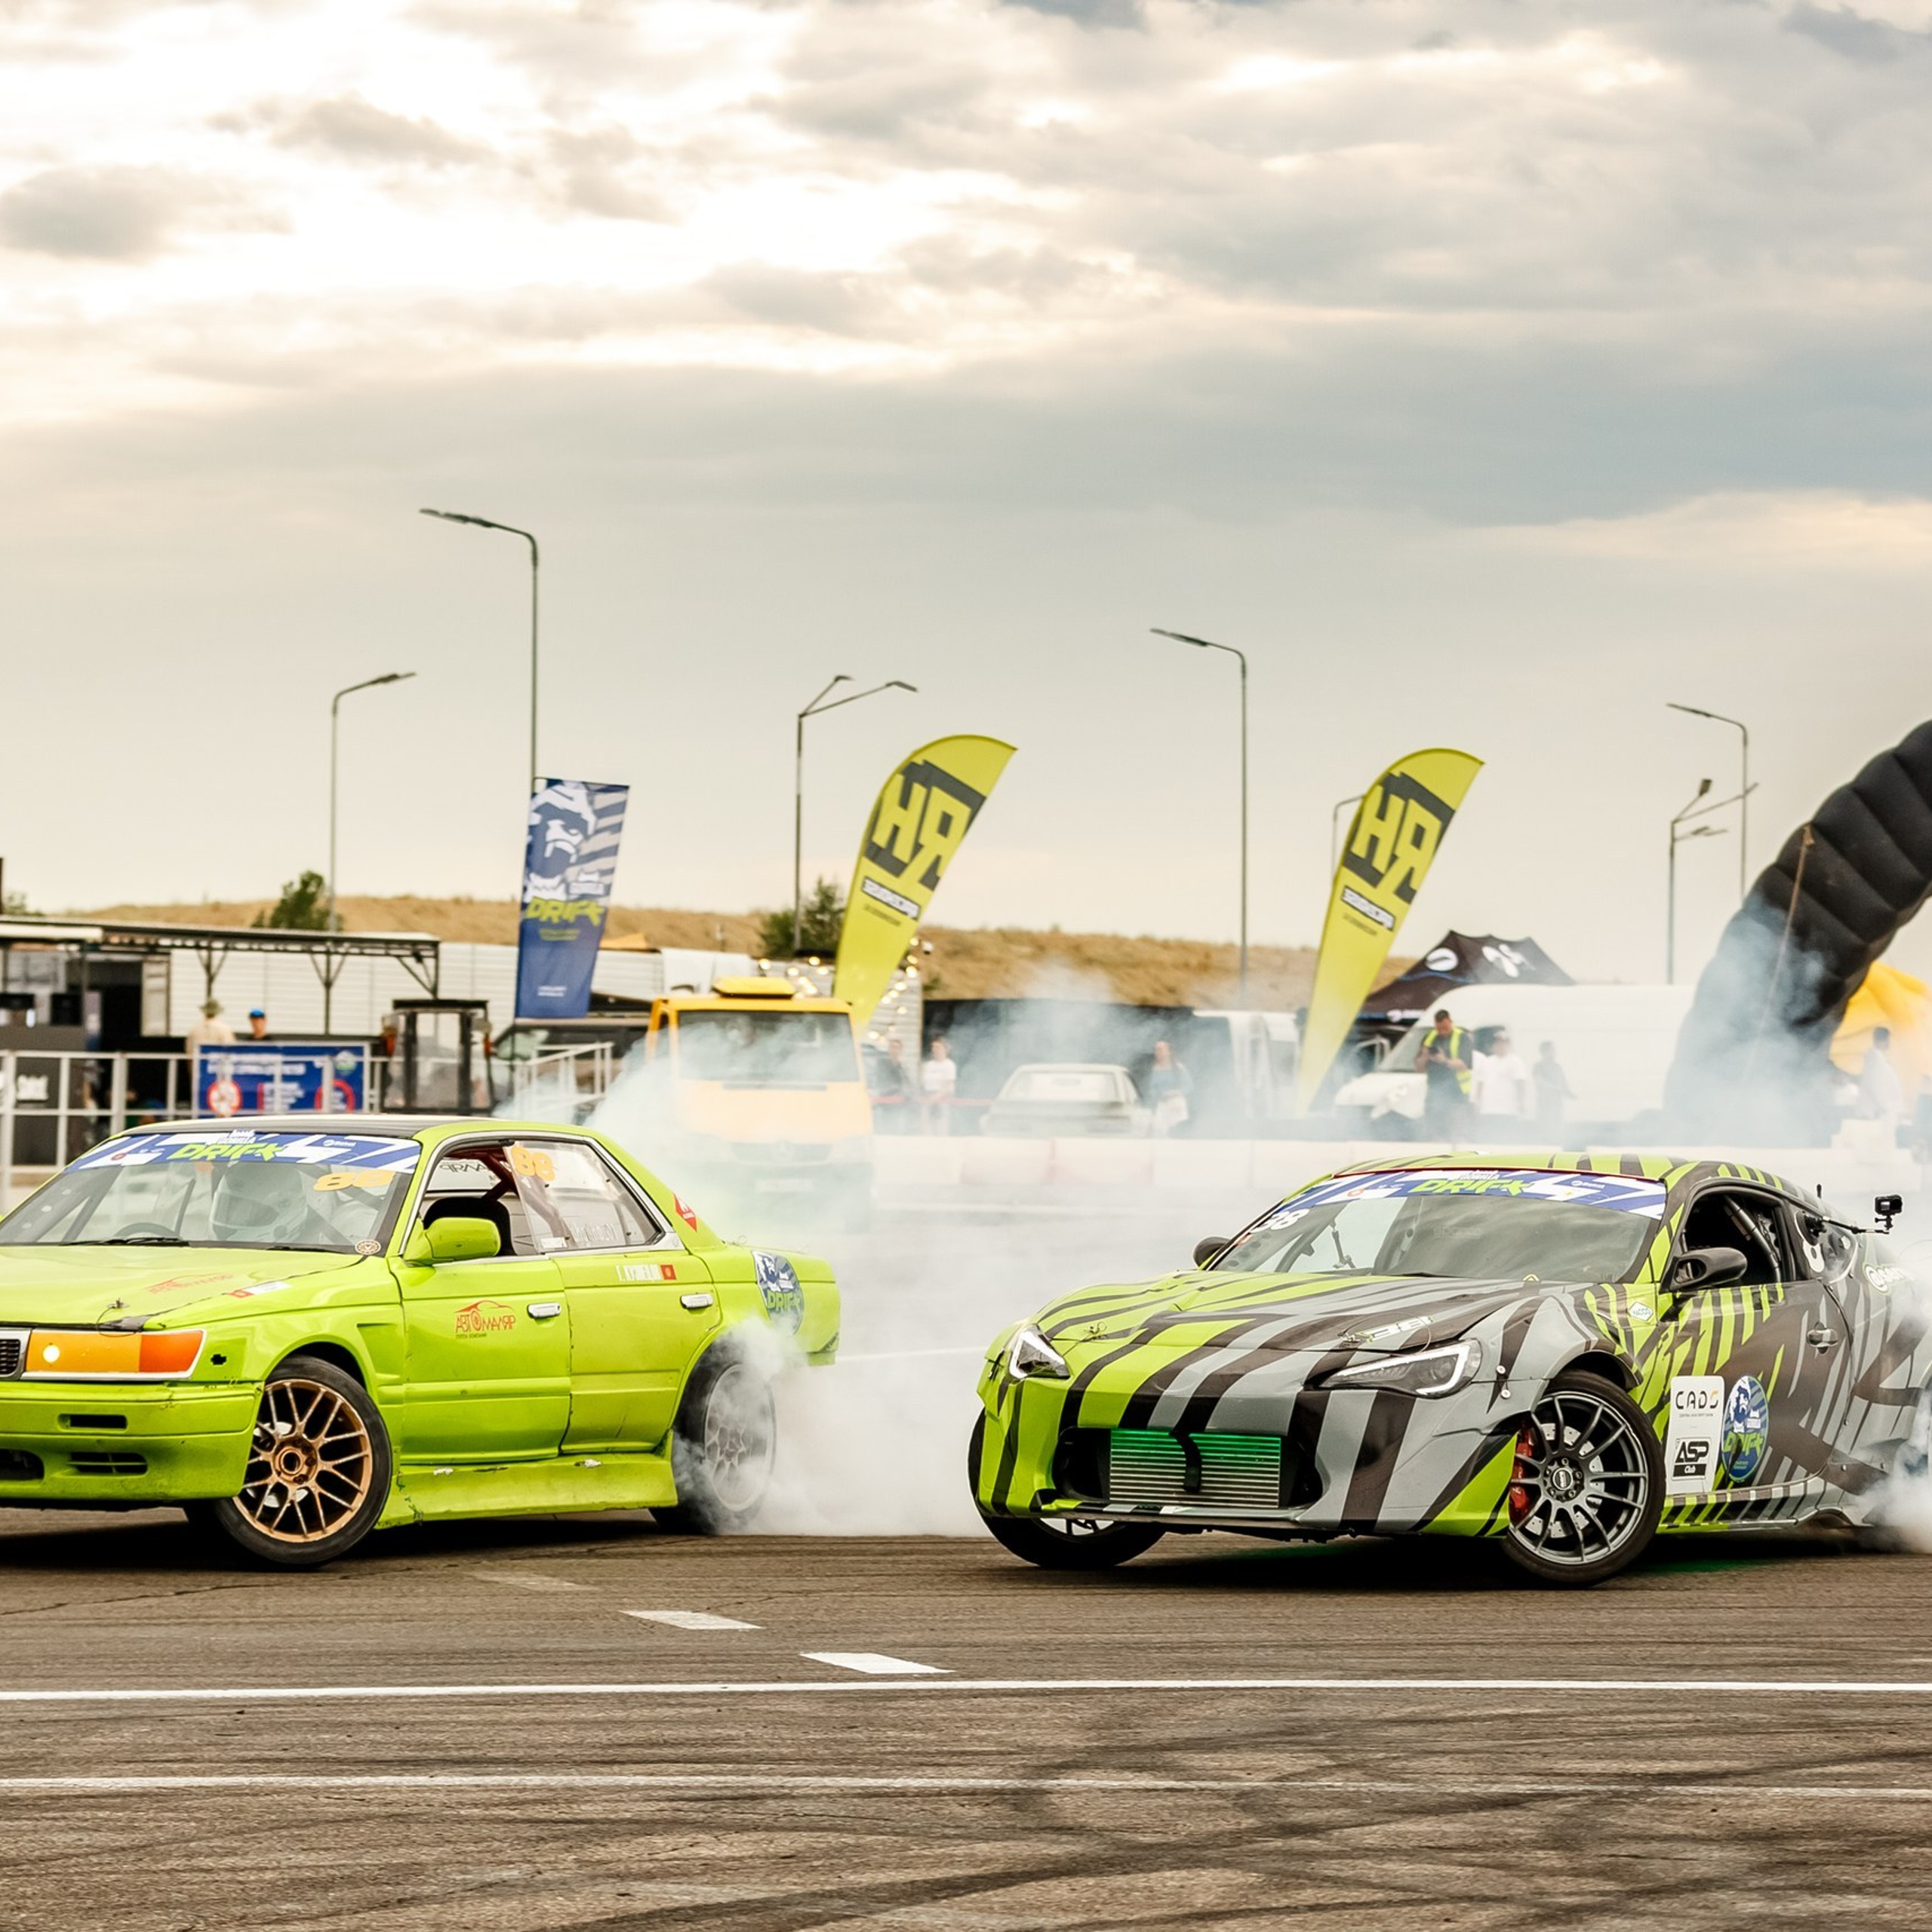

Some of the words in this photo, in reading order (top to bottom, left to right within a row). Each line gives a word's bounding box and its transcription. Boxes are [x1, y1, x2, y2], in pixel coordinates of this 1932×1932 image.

[165, 1142, 288, 1162] DRIFT
[1408, 1180, 1534, 1196] DRIFT
[1675, 1390, 1719, 1410] CADS
[1675, 1441, 1709, 1463] ASP
